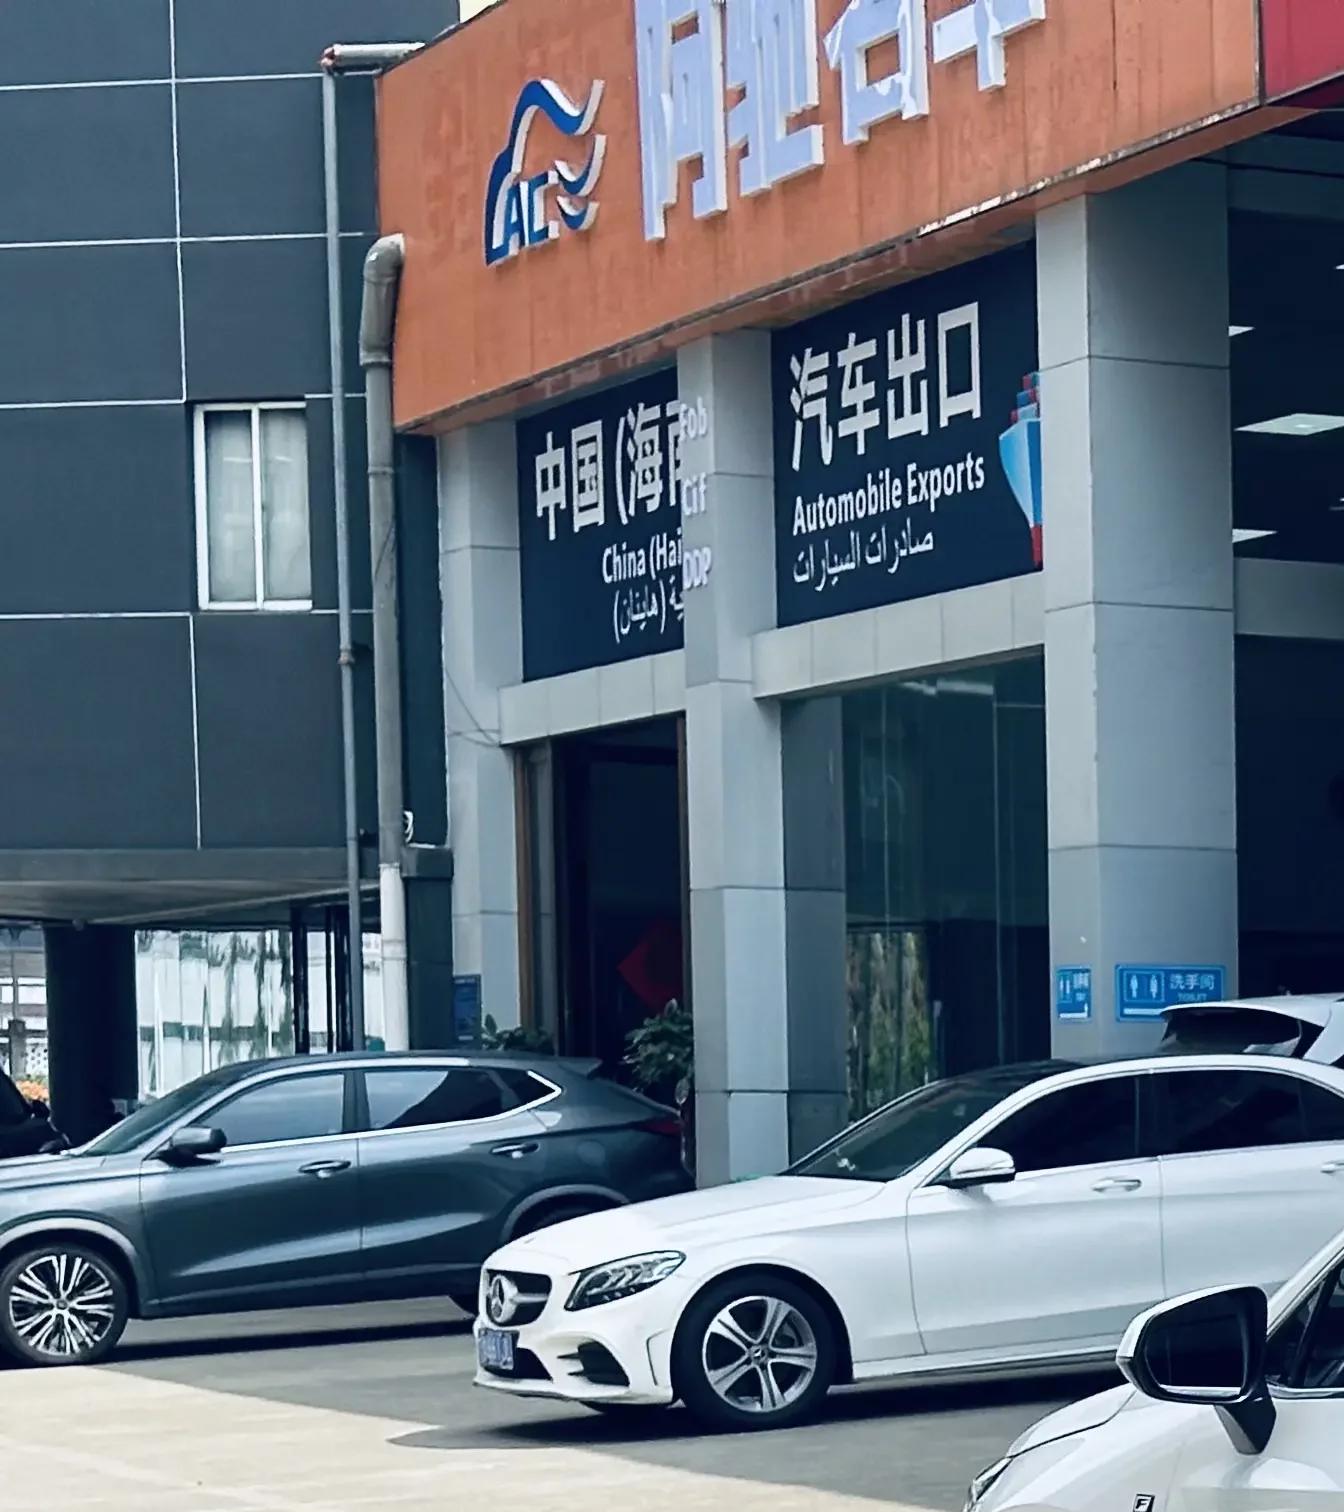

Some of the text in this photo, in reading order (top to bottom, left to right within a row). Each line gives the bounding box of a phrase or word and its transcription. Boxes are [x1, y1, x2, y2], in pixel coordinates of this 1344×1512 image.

[790, 302, 982, 471] 汽车出口
[792, 452, 985, 536] Automobile Exports
[602, 541, 646, 583] China
